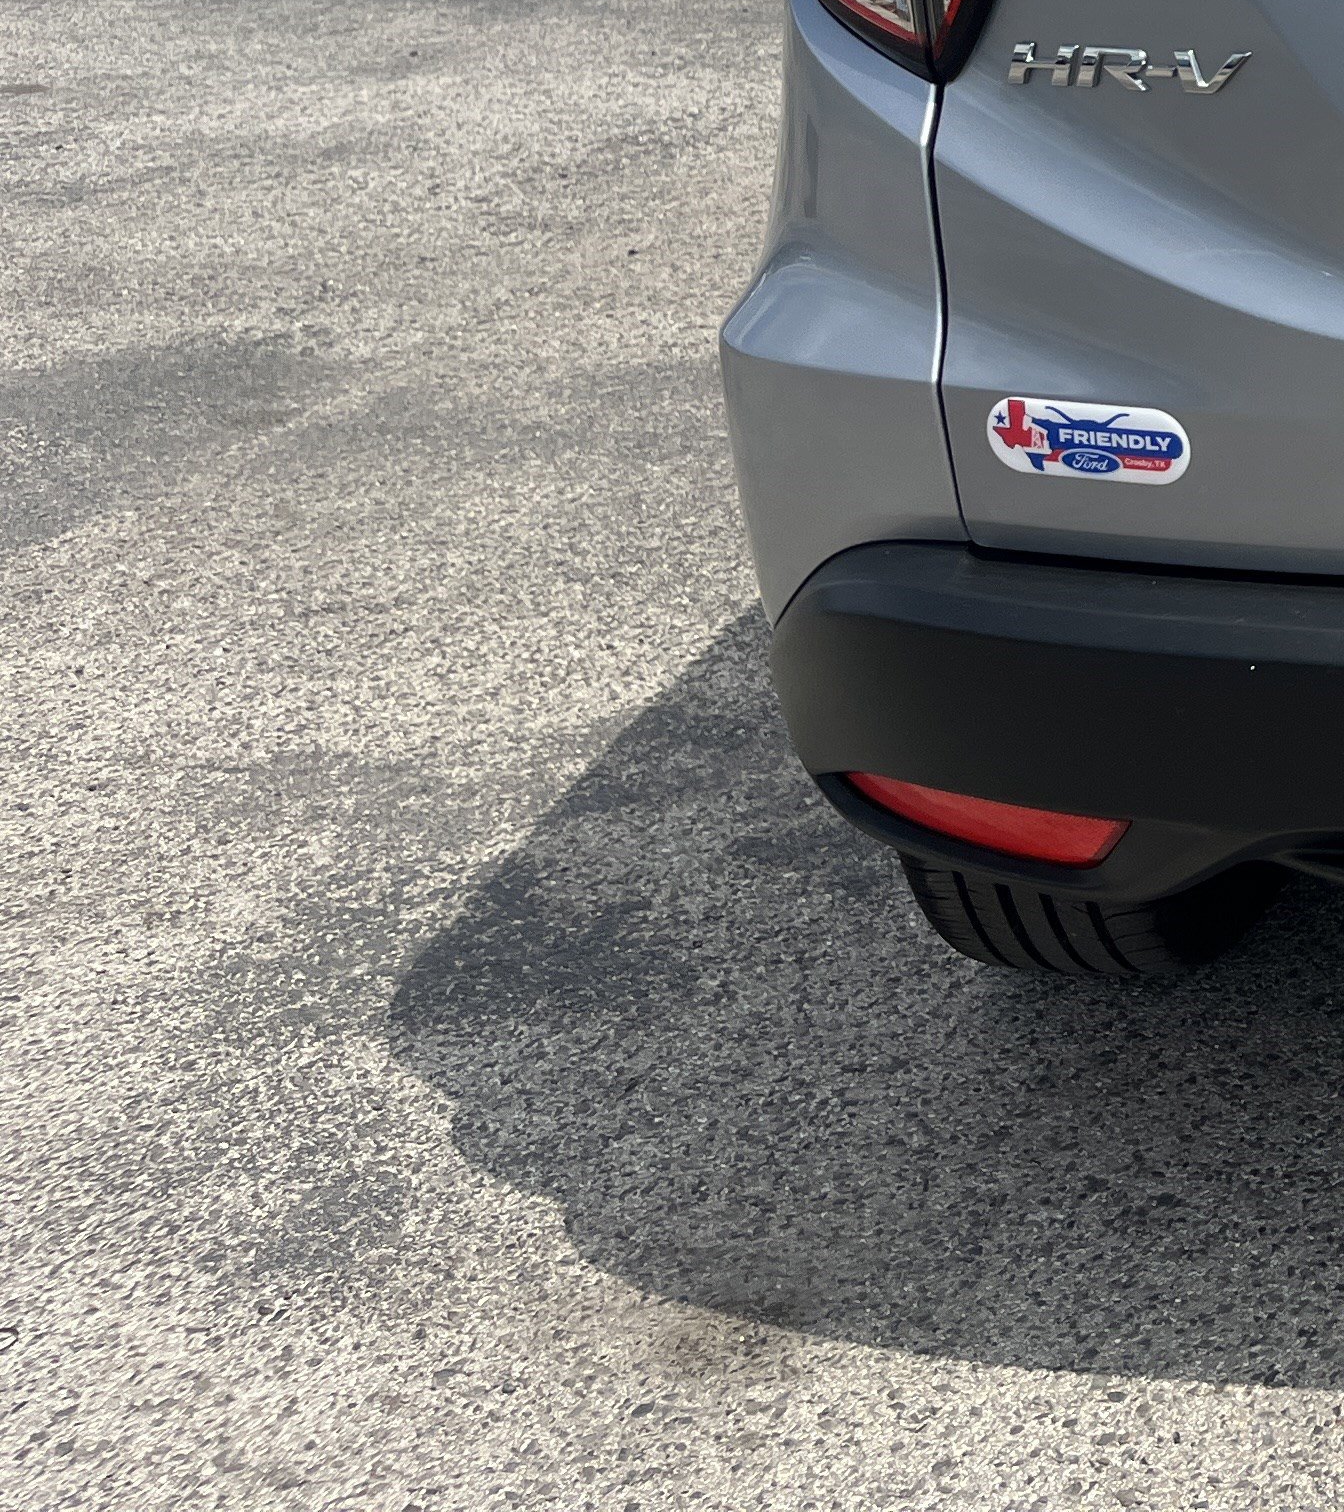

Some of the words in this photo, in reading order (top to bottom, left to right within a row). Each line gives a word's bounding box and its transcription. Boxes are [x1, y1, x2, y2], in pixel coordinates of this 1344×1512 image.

[1007, 41, 1254, 95] HR-V
[1058, 427, 1172, 452] FRIENDLY
[1071, 452, 1109, 471] Ford
